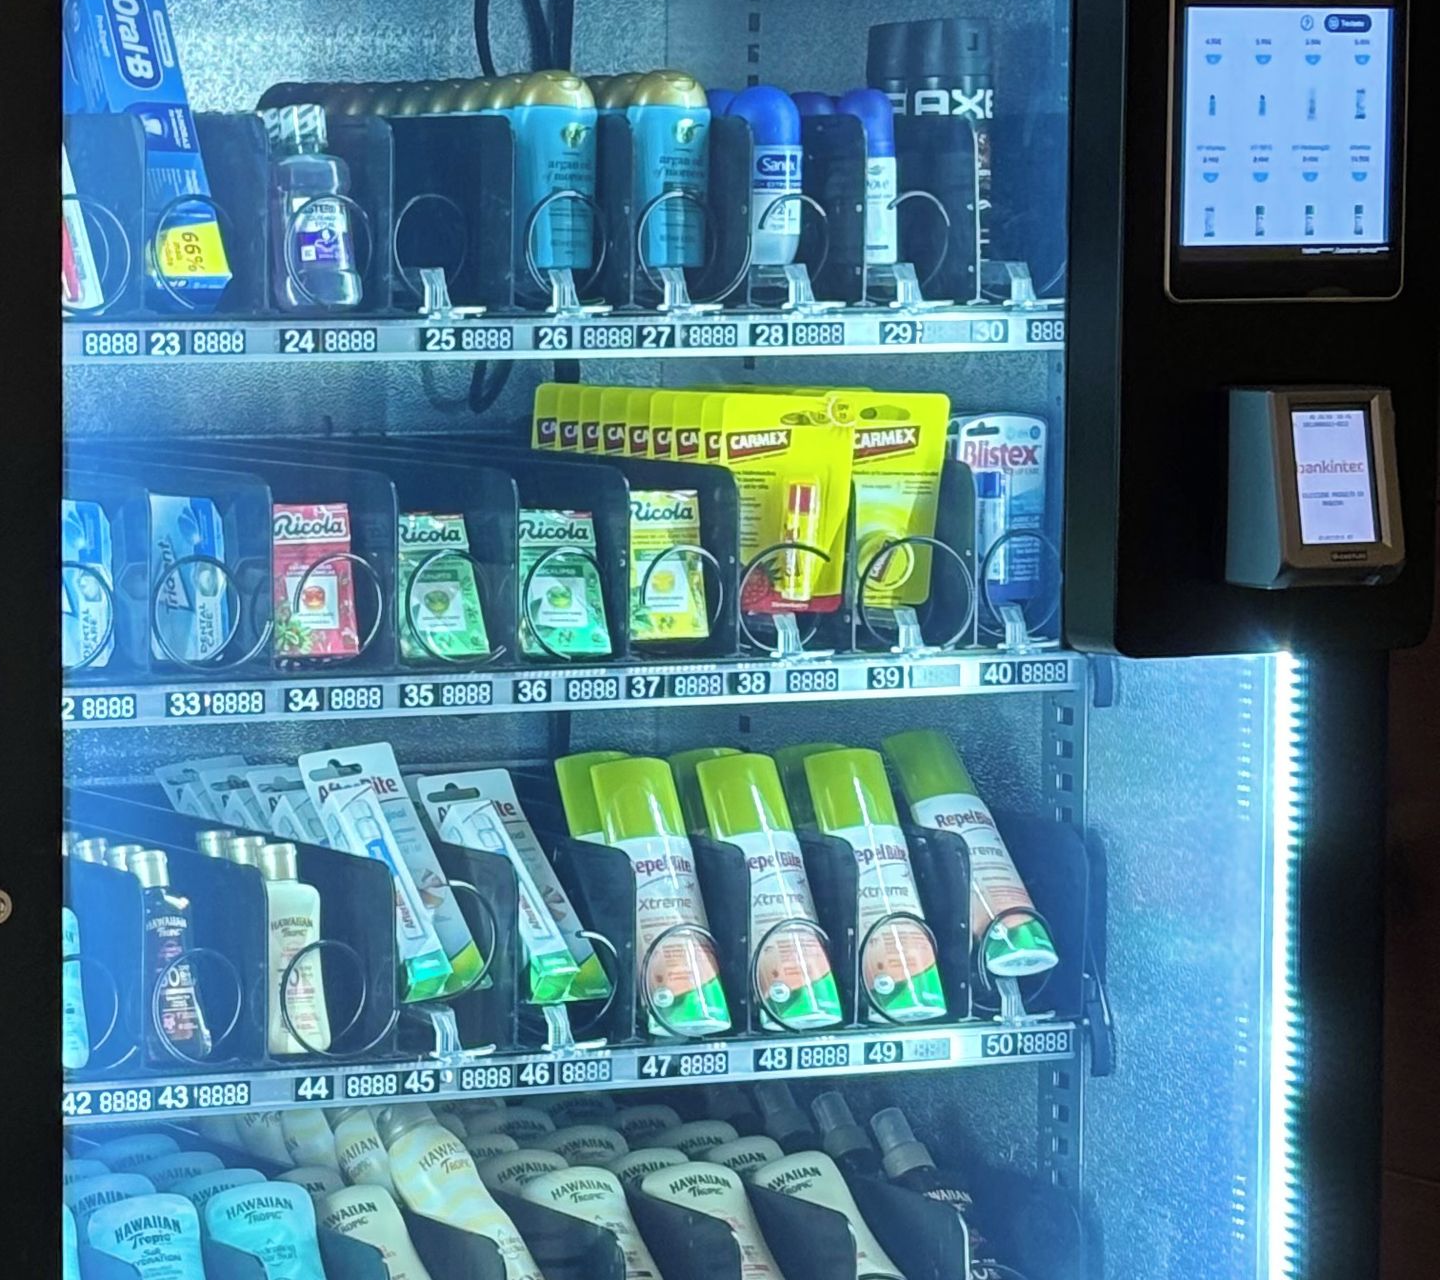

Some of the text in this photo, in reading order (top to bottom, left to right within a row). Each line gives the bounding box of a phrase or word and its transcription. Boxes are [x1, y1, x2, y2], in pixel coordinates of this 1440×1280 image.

[914, 88, 993, 119] AXE
[762, 157, 796, 172] Sanx
[182, 232, 205, 272] 66%
[151, 320, 1064, 356] 23 8888 24 8888 25 8888 26 8888 27 8888 28 29 30 888
[730, 431, 789, 450] CARMEX
[854, 428, 916, 448] CARMEX
[963, 440, 1041, 468] Blistex
[630, 501, 694, 521] Ricola
[274, 513, 344, 535] Ricola
[399, 524, 462, 543] Ricola
[519, 521, 589, 540] Ricola
[200, 602, 208, 653] DENTAL
[206, 614, 215, 647] CARE
[62, 662, 1066, 720] 2 8888 33 8888 34 8888 35 8888 36 37 8888 38 8888 39 40 8888
[638, 897, 692, 911] Xtreme
[752, 892, 804, 907] Xtreme
[271, 916, 313, 930] HAWAIIAN
[62, 1092, 91, 1115] 42
[99, 1090, 151, 1113] 8888
[158, 1085, 189, 1109] 43
[198, 1083, 249, 1106] 8888
[297, 1077, 329, 1100] 44
[405, 1070, 435, 1093] 45
[462, 1067, 512, 1088] 8888
[519, 1063, 550, 1085] 46
[562, 1062, 611, 1083] 8888
[642, 1056, 671, 1077] 47
[679, 1052, 727, 1076] 8888
[759, 1048, 787, 1070] 48
[800, 1046, 848, 1068] 8888
[868, 1041, 896, 1063] 49
[986, 1033, 1013, 1055] 50
[550, 1173, 615, 1201] HAWAIIAN
[669, 1173, 732, 1196] HAWAIIAN
[225, 1195, 294, 1220] HAWAIIAN
[114, 1214, 182, 1245] HAWAIIAN
[126, 1230, 175, 1250] Tropic
